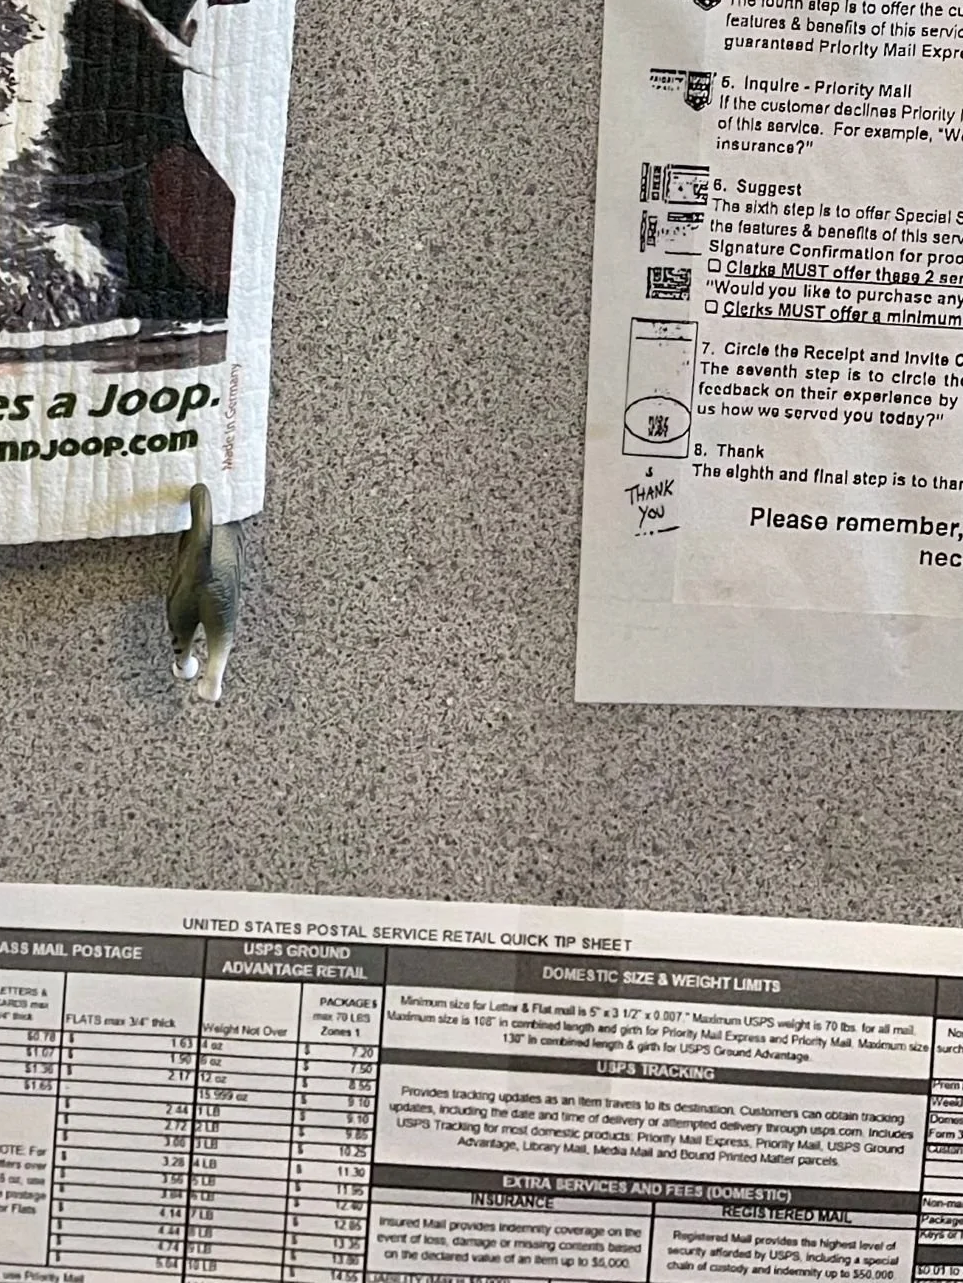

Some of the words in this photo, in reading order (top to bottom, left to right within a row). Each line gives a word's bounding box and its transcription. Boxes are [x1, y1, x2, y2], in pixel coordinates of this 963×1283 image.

[721, 76, 734, 89] 5.
[745, 75, 799, 93] Inquire
[815, 80, 874, 100] Priority
[879, 84, 911, 98] Mail
[716, 136, 813, 154] insurance?"
[713, 179, 726, 192] 6.
[737, 179, 801, 197] Suggest
[709, 239, 784, 257] Signature
[790, 243, 894, 261] Confirmation
[900, 248, 923, 263] for
[727, 261, 776, 277] Clerks
[782, 263, 829, 278] MUST
[833, 266, 871, 281] offer
[876, 268, 920, 284] these
[925, 270, 934, 284] 2
[706, 279, 764, 295] "Would
[768, 286, 796, 300] you
[804, 284, 830, 298] like
[836, 286, 851, 299] to
[857, 288, 932, 304] purchase
[937, 295, 963, 309] any
[702, 341, 714, 355] 7.
[725, 342, 769, 356] Circle
[775, 344, 798, 358] the
[804, 345, 865, 364] Receipt
[870, 350, 899, 363] and
[905, 351, 949, 366] Invite
[47, 391, 77, 419] a
[88, 382, 220, 422] Joop.
[225, 363, 242, 419] Germany
[697, 405, 715, 415] us
[721, 402, 753, 416] how
[758, 407, 779, 418] we
[784, 407, 838, 420] served
[843, 410, 873, 425] you
[880, 411, 944, 429] today?"
[222, 437, 234, 471] Made
[694, 443, 707, 456] 8.
[716, 443, 764, 459] Thank
[624, 479, 674, 505] THANK
[638, 505, 665, 528] YOU
[750, 507, 828, 531] Please
[836, 515, 963, 541] remember,
[183, 918, 239, 932] UNITED
[244, 920, 302, 934] STATES
[306, 923, 367, 938] POSTAL
[373, 926, 438, 941] SERVICE
[442, 929, 496, 944] RETAIL
[500, 933, 549, 947] QUICK
[554, 935, 576, 948] TIP
[582, 937, 633, 951] SHEET
[33, 943, 68, 957] MAIL
[72, 944, 143, 960] POSTAGE
[243, 942, 283, 956] USPS
[286, 944, 351, 959] GROUND
[222, 960, 313, 978] ADVANTAGE
[316, 966, 368, 980] RETAIL
[542, 966, 618, 983] DOMESTIC
[622, 970, 655, 985] SIZE
[672, 974, 731, 990] WEIGHT
[734, 977, 781, 993] LIMITS
[66, 1013, 101, 1025] FLATS
[202, 1022, 239, 1037] Weight
[241, 1024, 260, 1036] Not
[262, 1025, 288, 1038] Over
[320, 1026, 352, 1037] Zones
[597, 1060, 636, 1075] USPS
[642, 1062, 715, 1080] TRACKING
[503, 1175, 552, 1190] EXTRA
[557, 1178, 628, 1194] SERVICES
[631, 1182, 663, 1196] AND
[665, 1183, 703, 1197] FEES
[707, 1186, 792, 1203] (DOMESTIC)
[470, 1193, 554, 1209] INSURANCE
[722, 1205, 815, 1223] REGISTERED
[818, 1211, 853, 1224] MAIL
